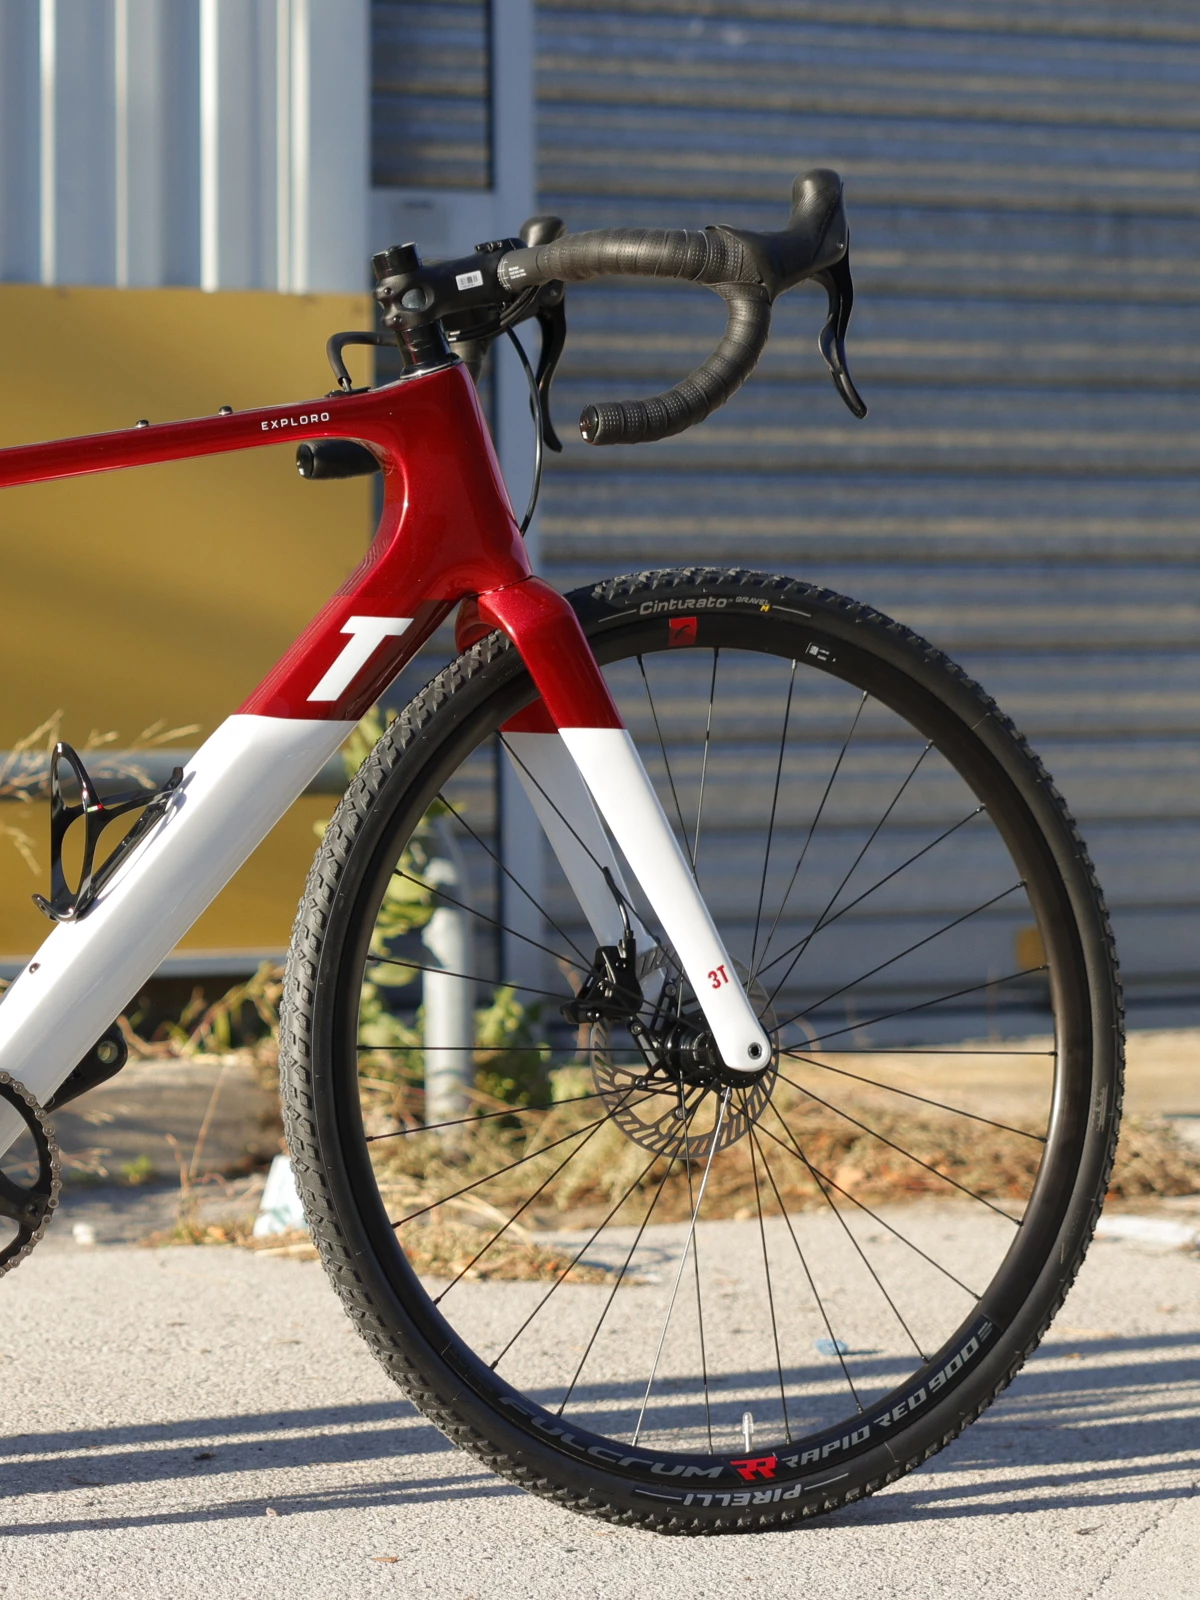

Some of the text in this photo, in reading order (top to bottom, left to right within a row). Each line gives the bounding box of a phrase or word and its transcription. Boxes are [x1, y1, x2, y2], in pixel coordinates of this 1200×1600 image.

[261, 412, 329, 431] EXPLORO
[639, 596, 771, 615] Cinturato GRAVEL
[707, 964, 731, 989] 3T
[498, 1396, 724, 1479] FULCRUM
[780, 1424, 871, 1468] RAPID
[873, 1386, 928, 1428] RED
[927, 1335, 980, 1394] 900
[682, 1483, 802, 1507] PIRELLI
